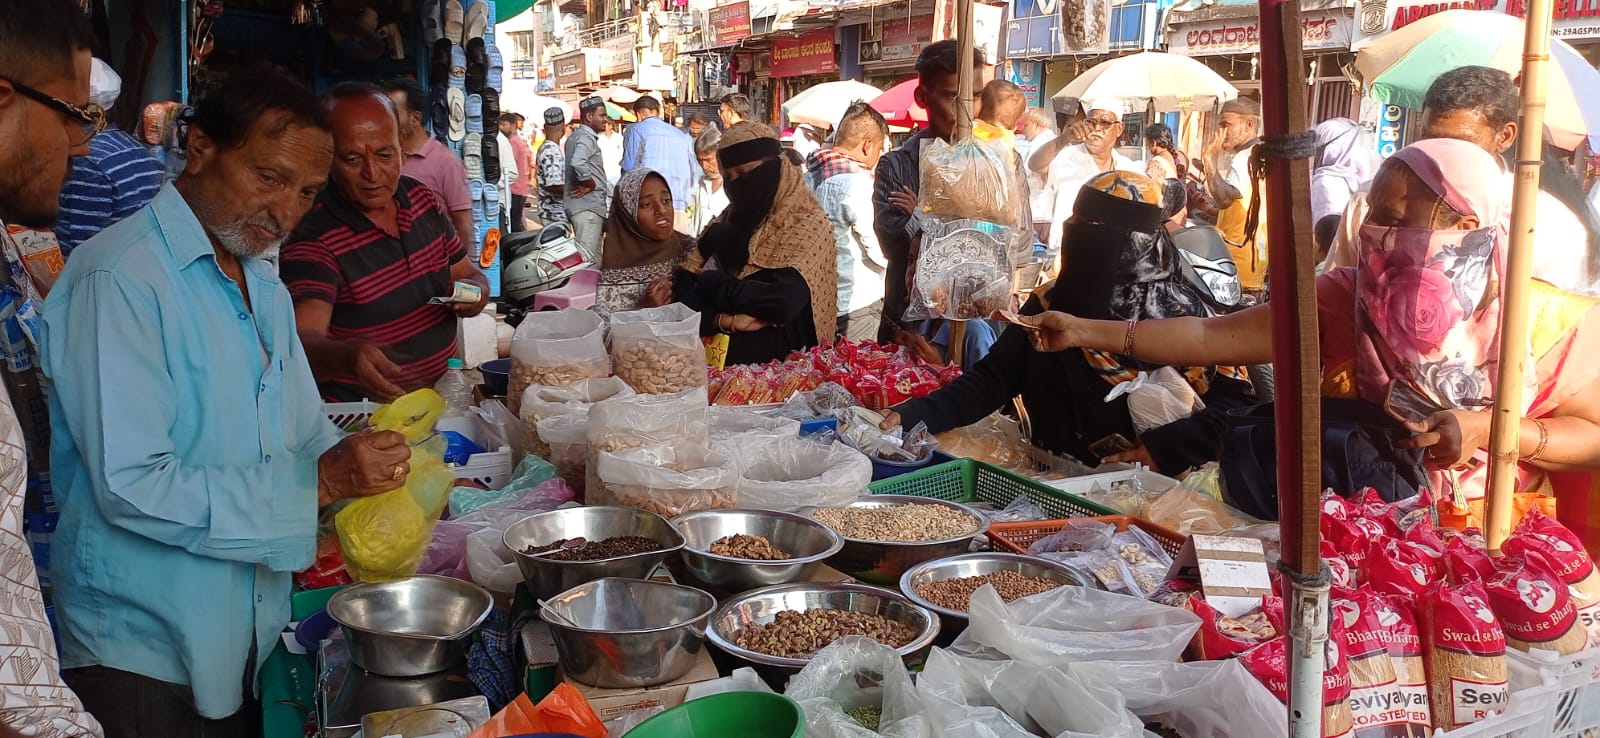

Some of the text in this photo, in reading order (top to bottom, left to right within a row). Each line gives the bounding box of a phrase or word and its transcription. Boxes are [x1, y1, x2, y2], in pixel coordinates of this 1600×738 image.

[1536, 621, 1551, 632] se
[1442, 628, 1480, 643] Swad
[1482, 632, 1492, 642] se
